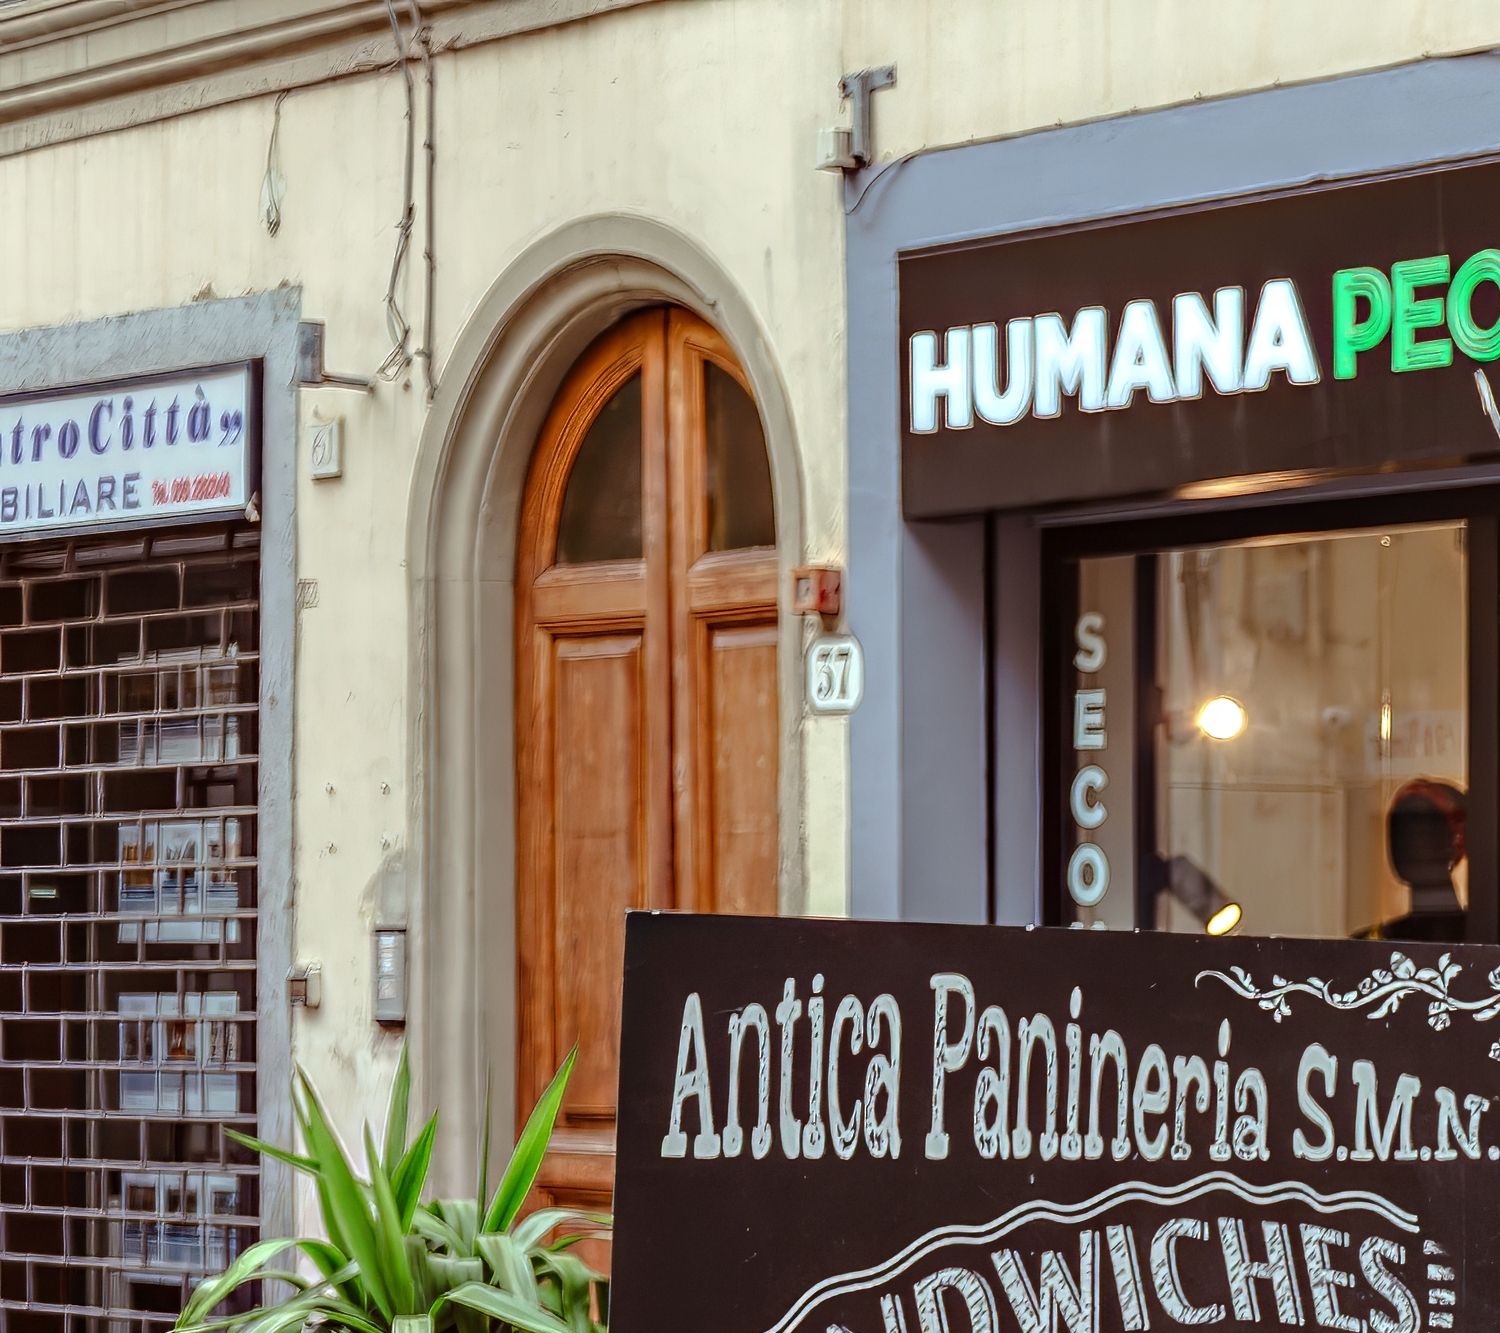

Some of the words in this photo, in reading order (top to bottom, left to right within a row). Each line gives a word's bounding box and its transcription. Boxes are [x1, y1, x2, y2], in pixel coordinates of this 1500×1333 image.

[909, 278, 1320, 435] HUMANA
[816, 646, 852, 701] 37
[1067, 611, 1111, 929] SECO
[660, 972, 902, 1161] Antica
[925, 972, 1270, 1162] Panineria
